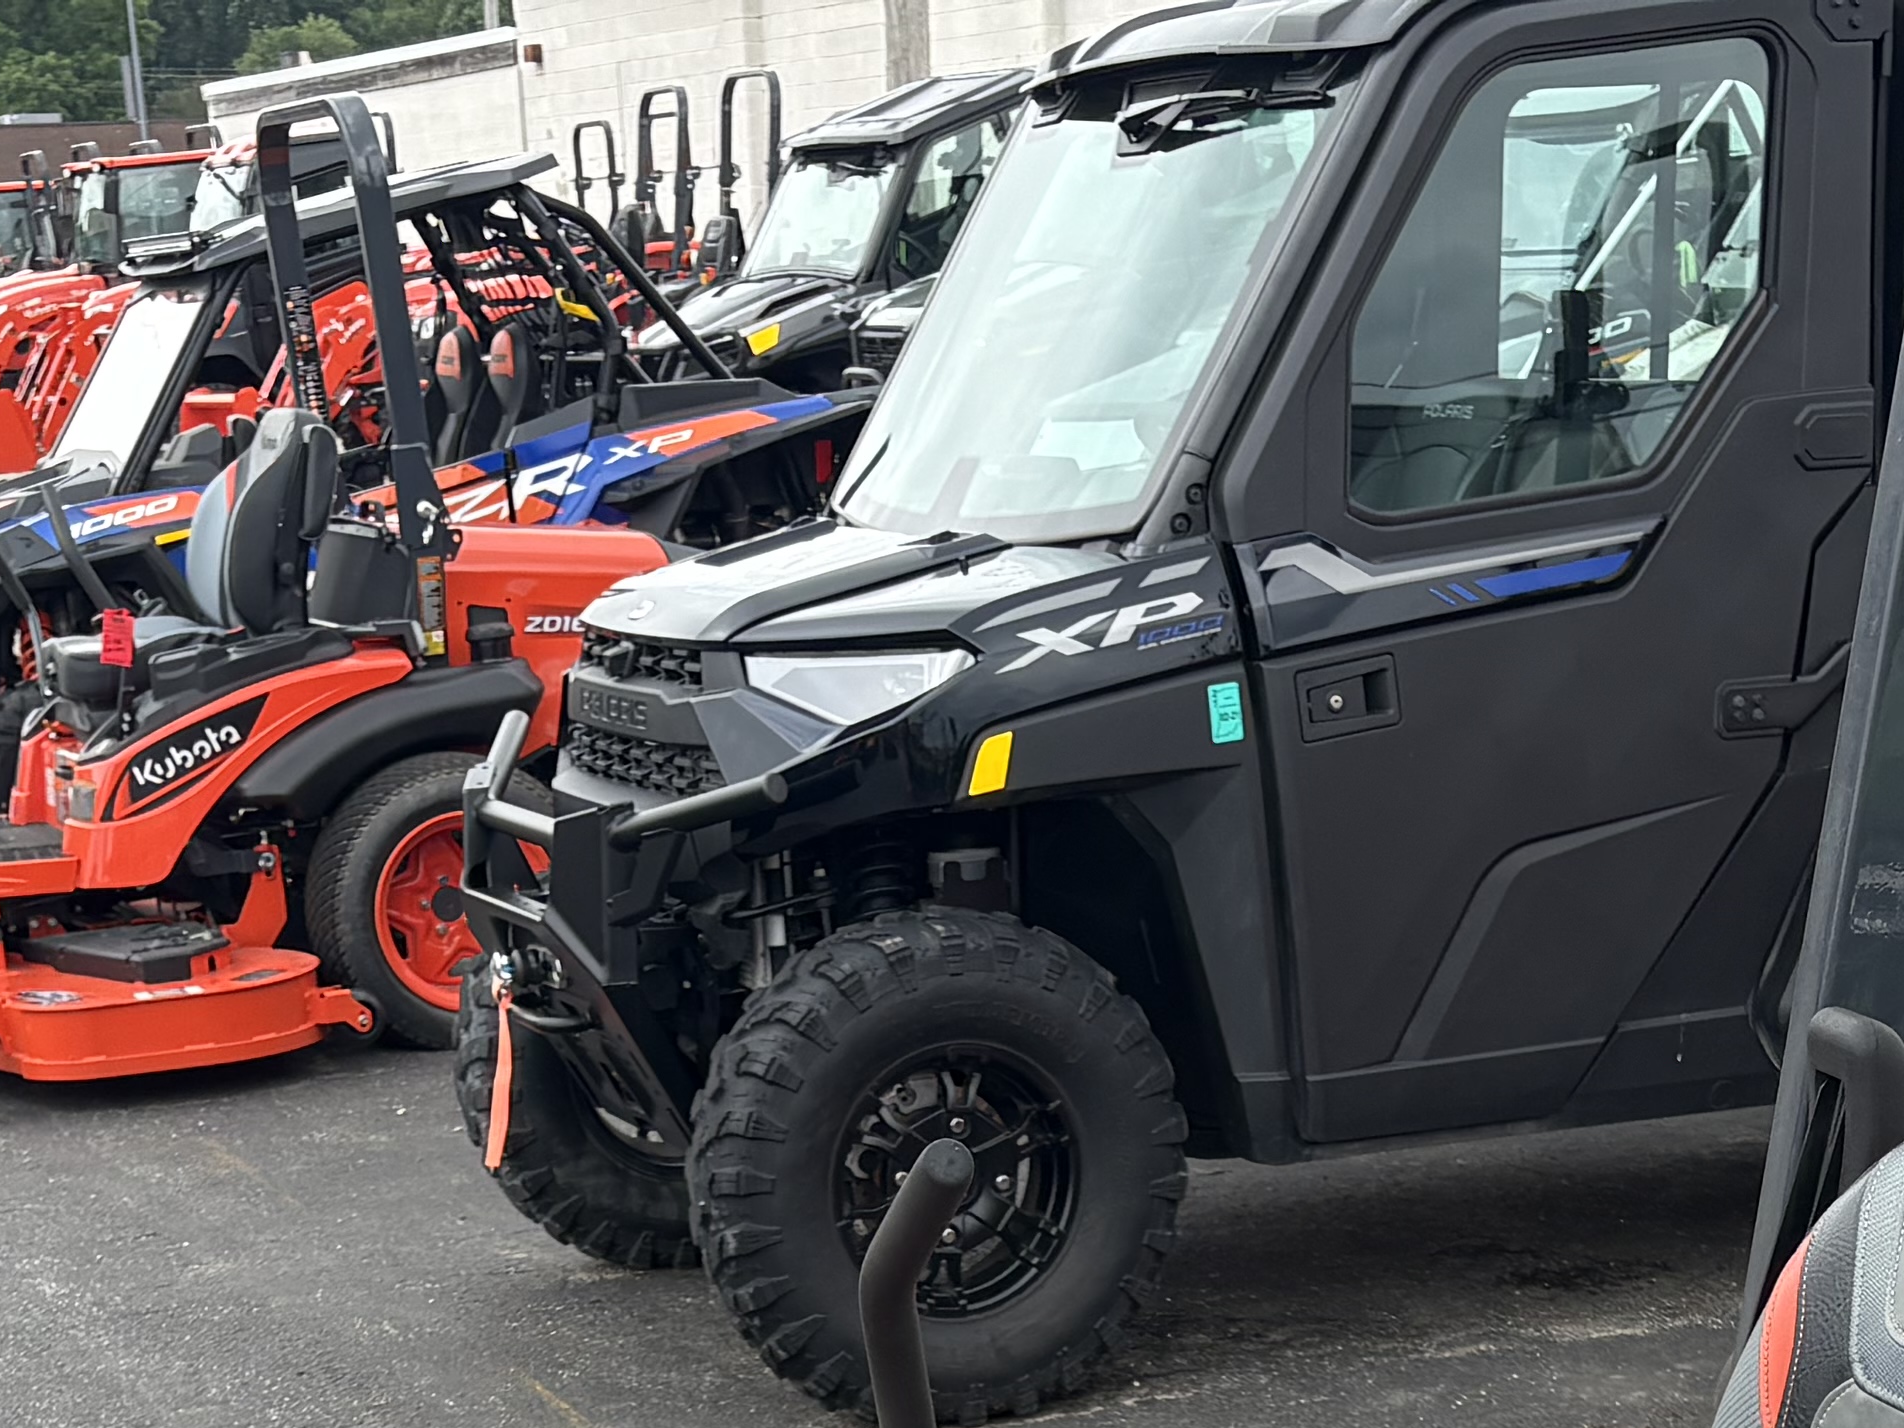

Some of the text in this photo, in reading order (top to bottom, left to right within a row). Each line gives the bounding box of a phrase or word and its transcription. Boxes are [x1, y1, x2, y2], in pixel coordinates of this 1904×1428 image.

[1423, 404, 1475, 421] POLARIS
[446, 428, 694, 523] ZR XP
[994, 591, 1225, 675] XP 1000
[581, 687, 648, 732] POLARIS
[132, 725, 243, 786] Kubota
